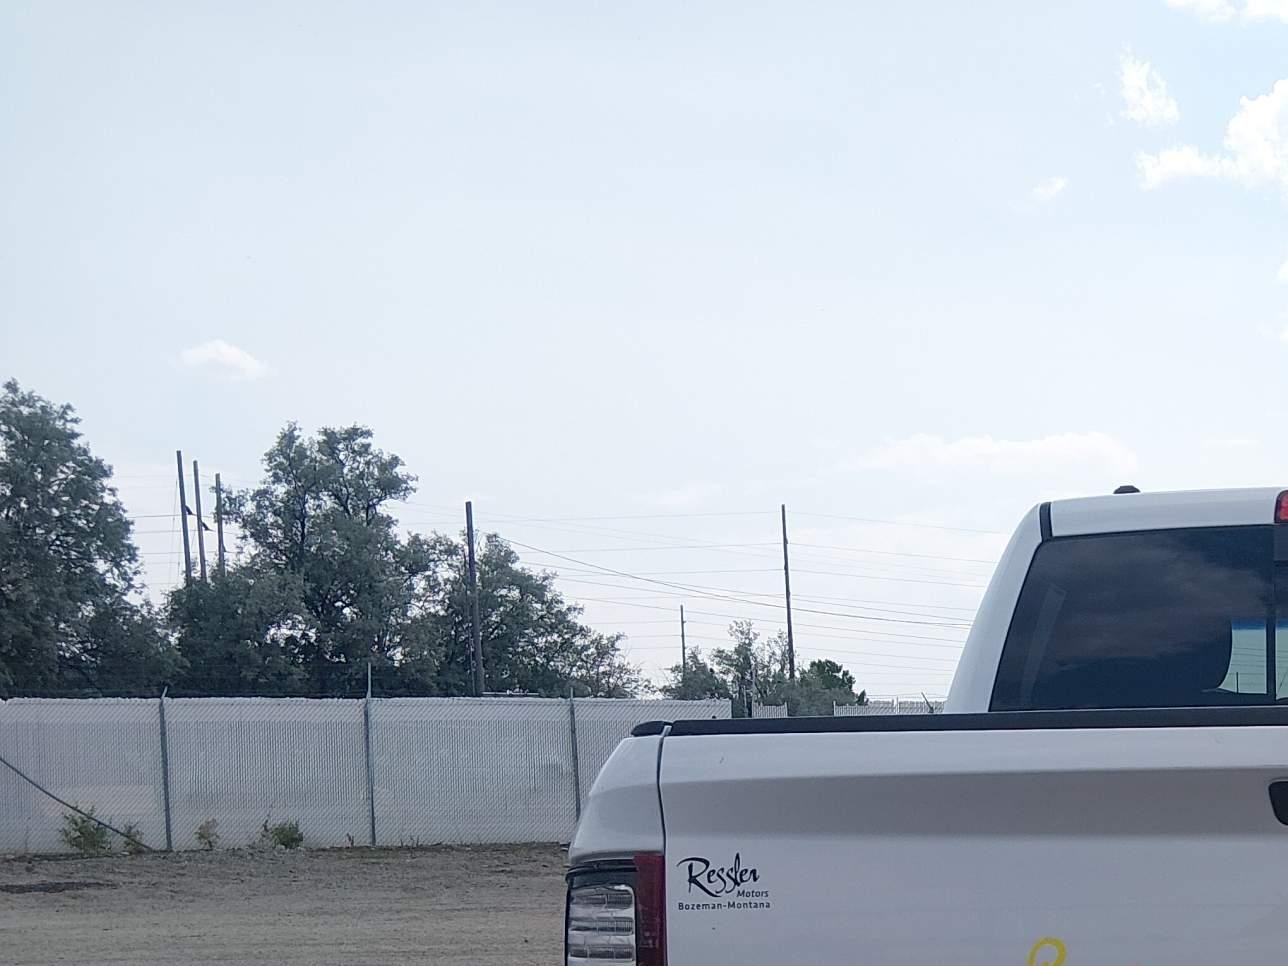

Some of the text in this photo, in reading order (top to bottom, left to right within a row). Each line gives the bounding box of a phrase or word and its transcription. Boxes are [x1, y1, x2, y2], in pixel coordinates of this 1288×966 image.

[676, 852, 760, 897] Ressler
[736, 890, 769, 898] Motors
[678, 901, 771, 911] Bozeman-Montana
